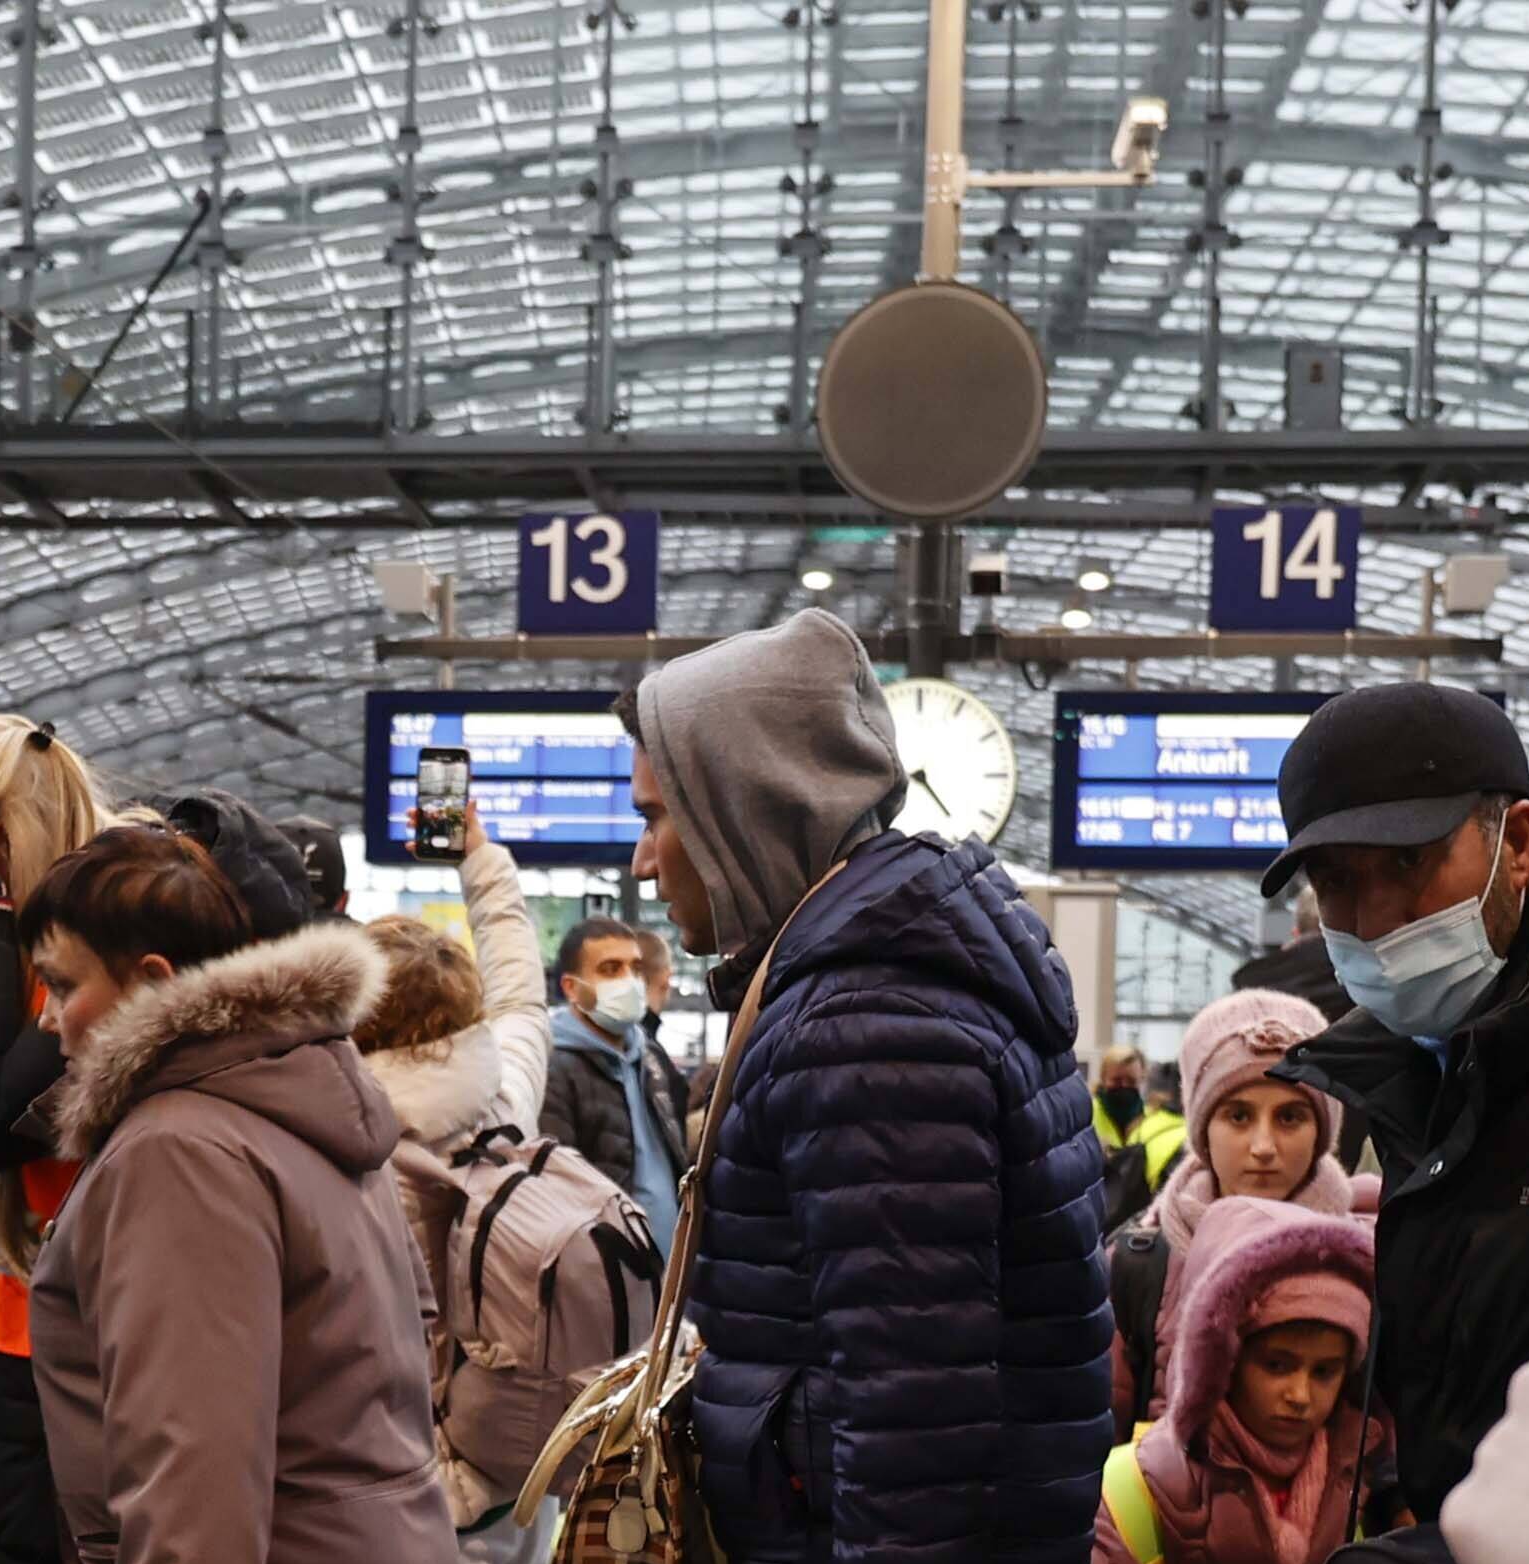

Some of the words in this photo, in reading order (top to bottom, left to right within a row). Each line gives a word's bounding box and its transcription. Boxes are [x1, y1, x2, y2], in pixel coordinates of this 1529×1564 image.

[531, 515, 628, 604] 13
[1243, 509, 1345, 599] 14
[1156, 748, 1250, 774] Ankunft
